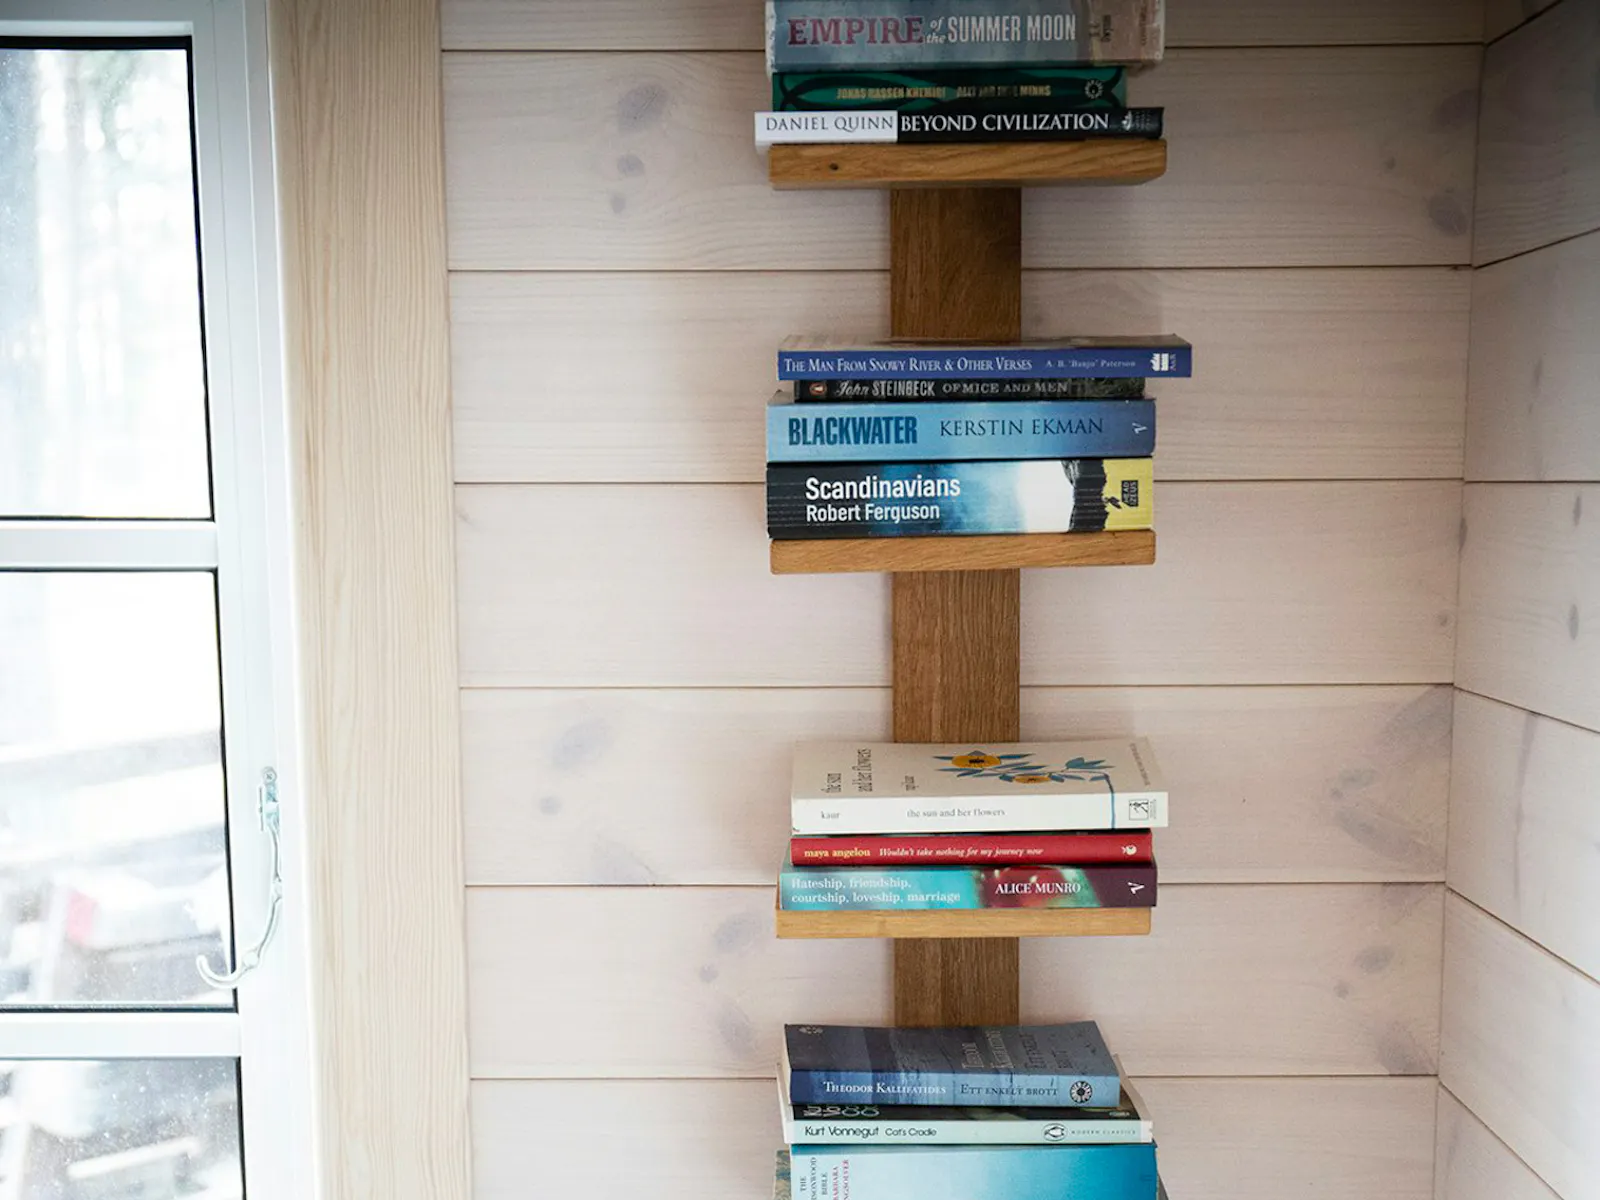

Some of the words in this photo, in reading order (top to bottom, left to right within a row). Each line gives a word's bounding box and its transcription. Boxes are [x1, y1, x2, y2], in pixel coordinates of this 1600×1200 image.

[929, 17, 944, 31] of
[948, 16, 1021, 42] SUMMER
[1027, 14, 1076, 41] MOON
[787, 17, 924, 45] EMPIRE
[926, 33, 946, 44] the
[766, 117, 828, 131] DANIEL
[834, 116, 893, 133] QUINN
[901, 115, 977, 132] BEYOND
[982, 114, 1109, 131] CIVILIZATION
[784, 358, 805, 373] THE
[808, 358, 835, 372] MAN
[837, 358, 866, 372] FROM
[869, 357, 906, 372] SNOWY
[909, 357, 941, 372] RIVER
[944, 359, 954, 371] &
[957, 357, 994, 371] OTHER
[996, 357, 1033, 371] VERSES
[1101, 360, 1136, 368] Paterson
[834, 381, 869, 396] John
[872, 381, 936, 396] STEINBECK
[942, 383, 961, 393] OF
[962, 383, 999, 394] MICE
[1003, 383, 1031, 393] AND
[1034, 382, 1068, 393] MEN
[788, 416, 918, 446] BLACKWATER
[940, 420, 1023, 436] KERSTIN
[1032, 418, 1103, 435] EKMAN
[805, 474, 961, 500] Scandinavians
[806, 504, 861, 522] Robert
[865, 503, 940, 524] Ferguson
[821, 811, 840, 819] kaur
[906, 809, 920, 817] the
[940, 809, 955, 817] and
[957, 809, 971, 817] her
[974, 808, 1005, 816] flowers
[804, 850, 829, 859] maya
[832, 848, 870, 858] angelou
[880, 848, 914, 856] Wouldn't
[916, 848, 933, 856] take
[935, 847, 964, 857] nothing
[966, 847, 979, 857] for
[980, 849, 993, 857] my
[994, 847, 1024, 857] journey
[995, 883, 1032, 894] ALICE
[1035, 882, 1081, 894] MUNRO
[907, 891, 960, 903] marriage
[823, 1081, 873, 1093] THEODOR
[876, 1082, 946, 1094] KALLIFATIDES
[960, 1084, 981, 1094] ETT
[985, 1086, 1023, 1095] ENKELT
[1026, 1088, 1058, 1096] BROTT
[805, 1126, 825, 1136] Kurt
[828, 1126, 879, 1138] Vonnegut
[885, 1127, 907, 1136] Cat's
[908, 1127, 937, 1136] Cradle
